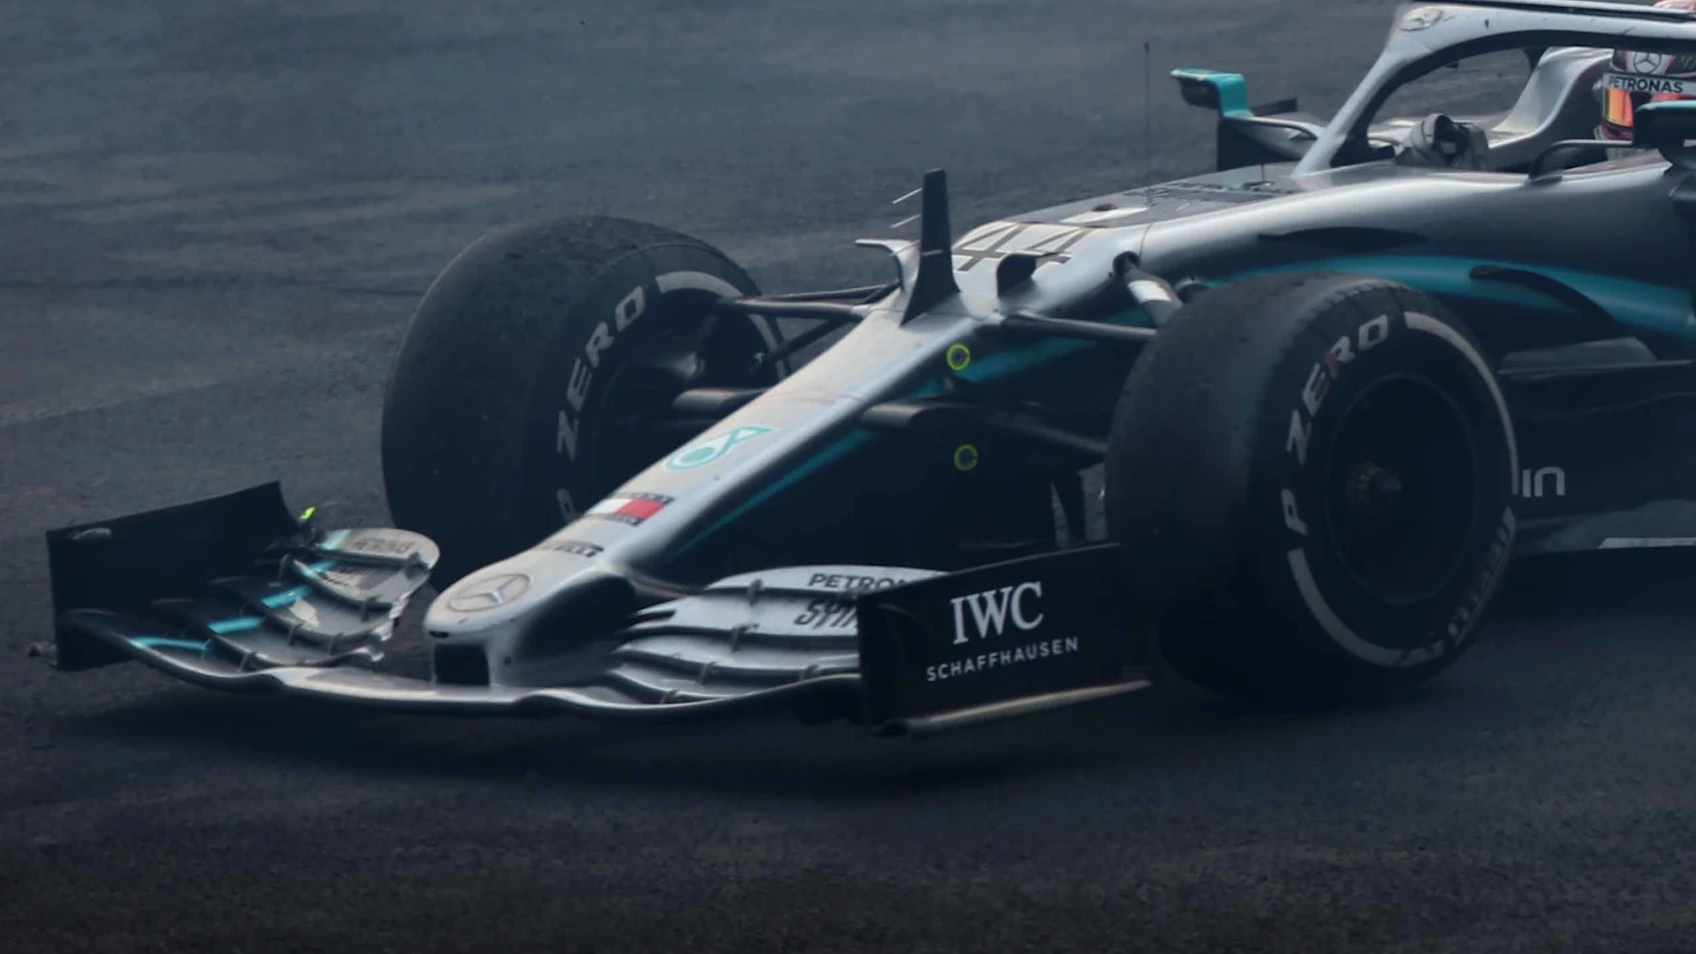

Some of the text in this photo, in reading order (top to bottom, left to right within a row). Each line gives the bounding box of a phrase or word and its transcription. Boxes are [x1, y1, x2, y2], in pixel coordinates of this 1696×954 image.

[1609, 66, 1684, 94] PETRONAS
[556, 285, 646, 463] ZERO
[1280, 314, 1389, 536] P ZERO
[949, 580, 1045, 646] IWC
[925, 636, 1081, 682] SCHAFFHAUSEN
